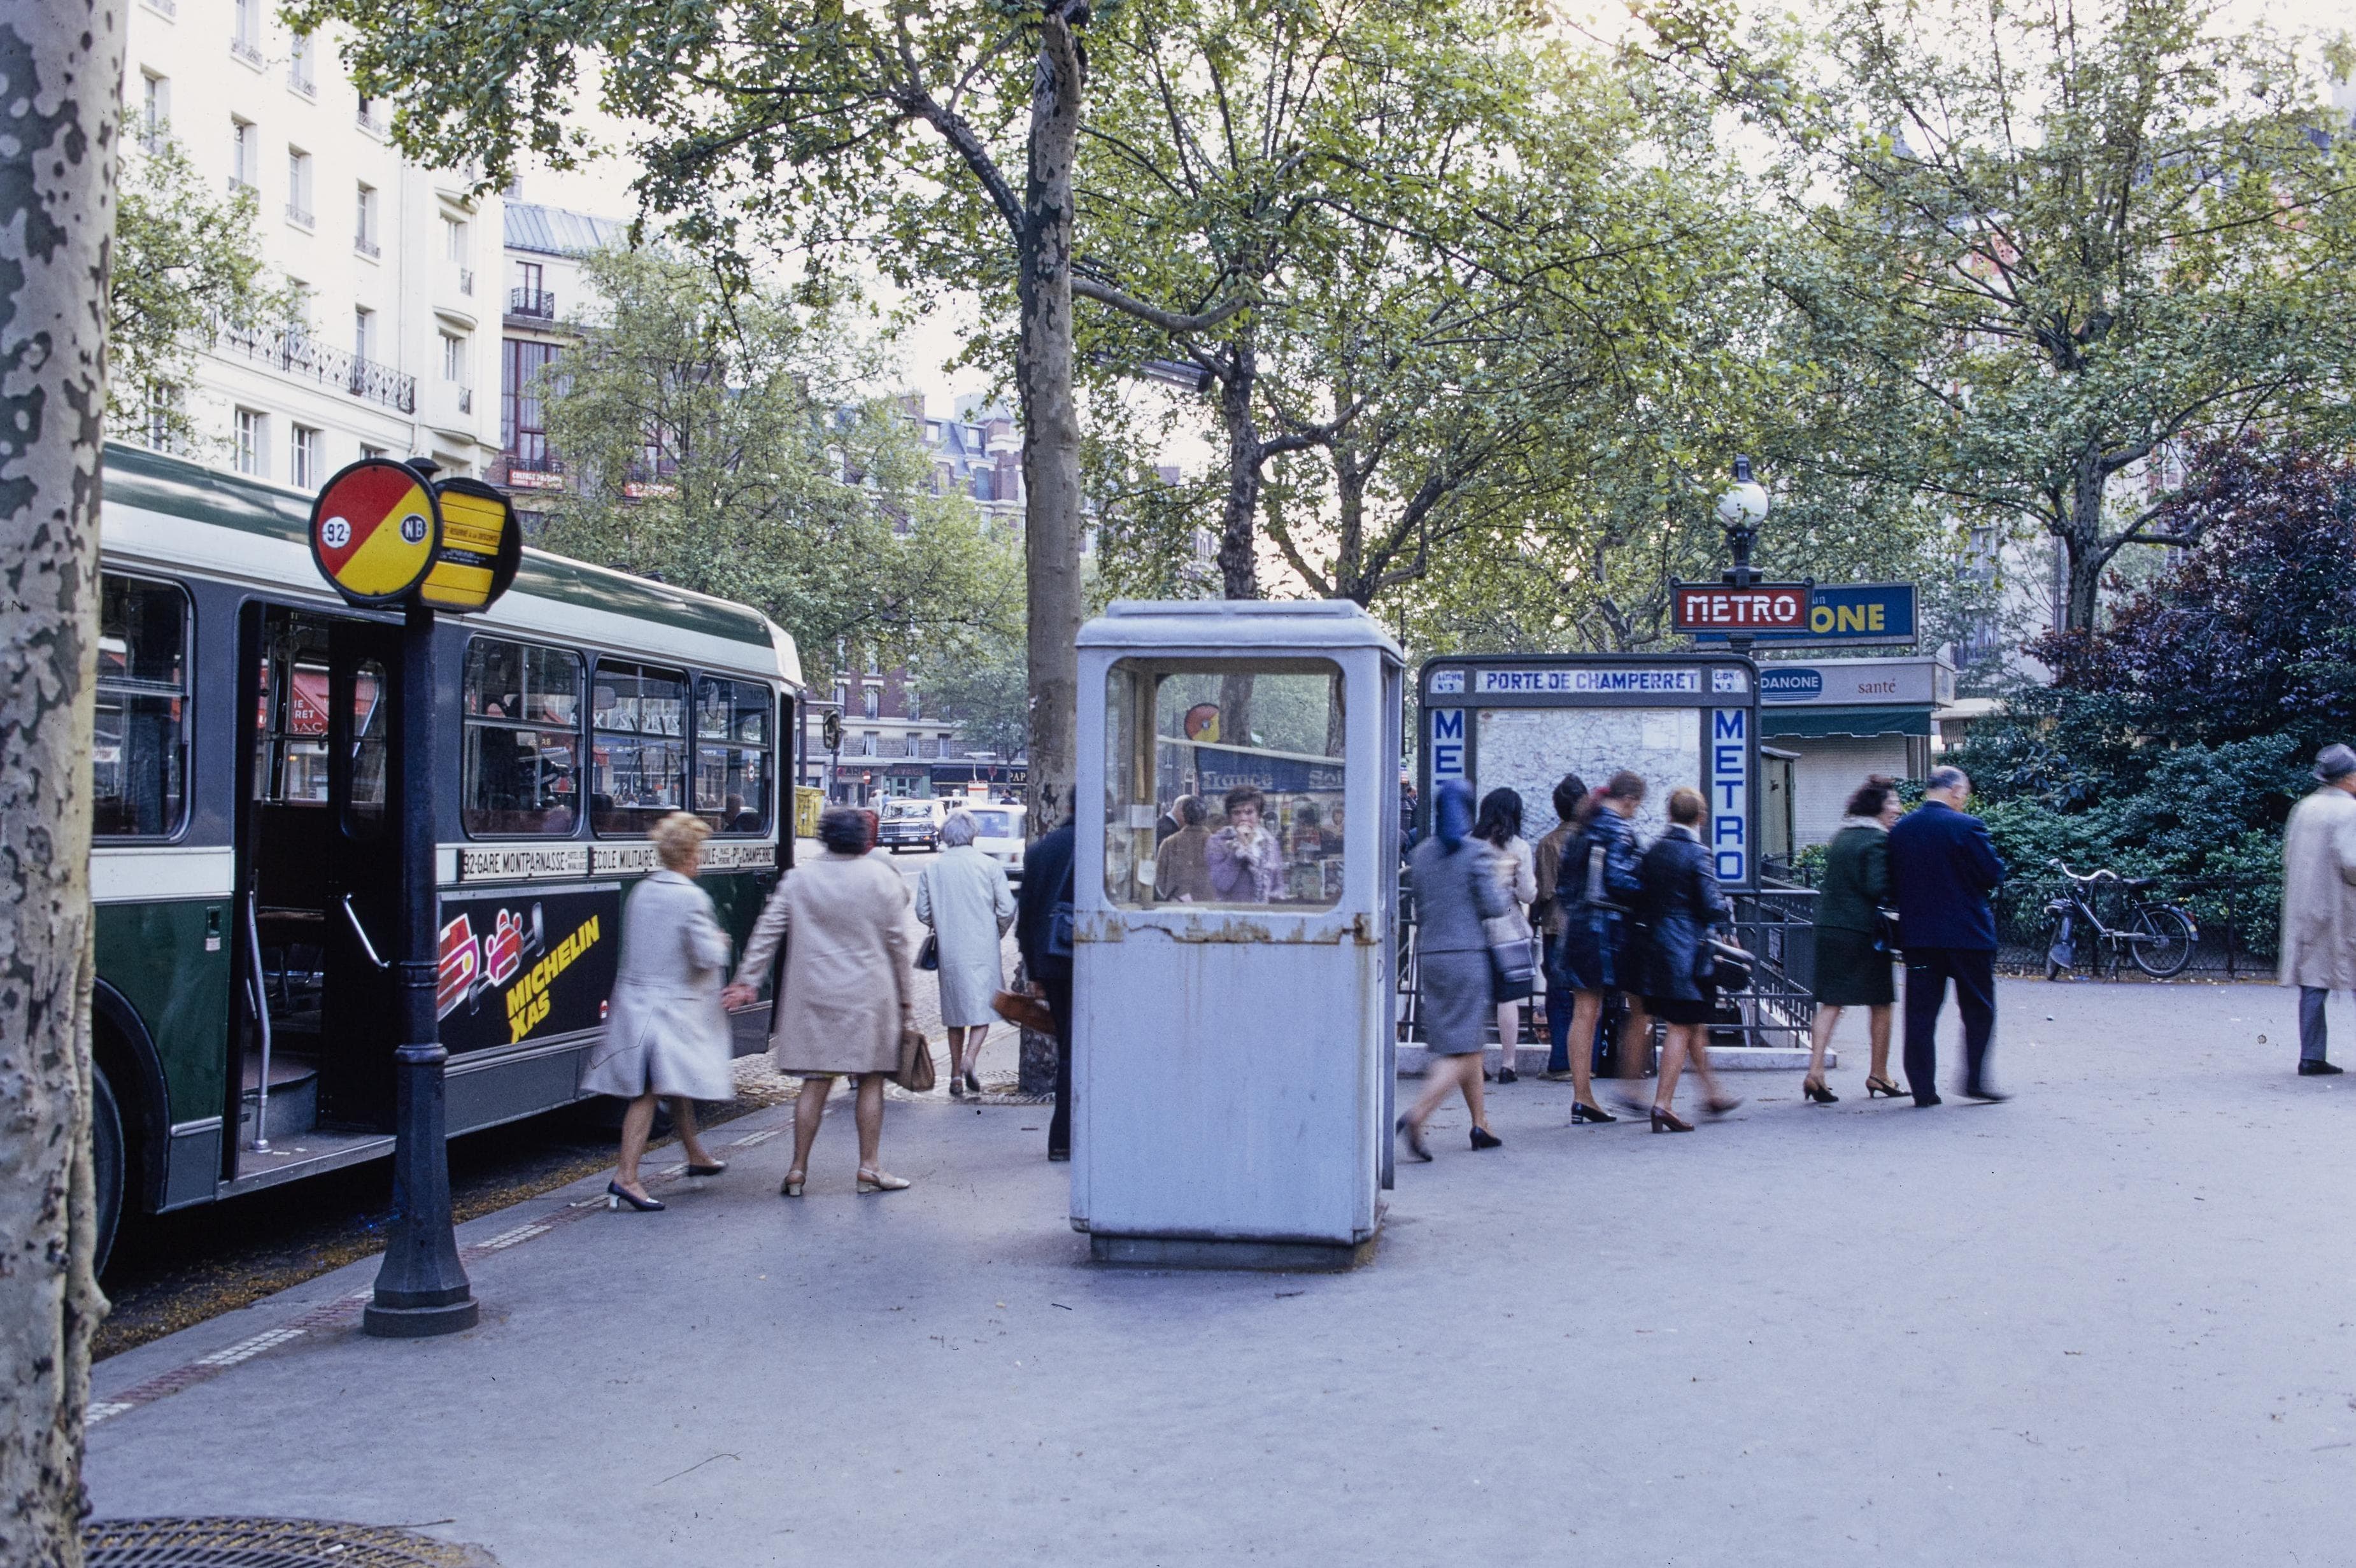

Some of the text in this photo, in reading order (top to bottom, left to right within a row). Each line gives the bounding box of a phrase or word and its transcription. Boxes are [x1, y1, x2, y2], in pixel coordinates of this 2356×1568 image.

[327, 524, 345, 542] 92
[405, 518, 424, 540] NB
[1686, 595, 1796, 622] METRO
[1487, 672, 1698, 689] PORTE DE CHAMPERRET
[1760, 675, 1819, 689] DANONE
[1858, 677, 1896, 695] santé
[1715, 709, 1743, 880] METRO
[593, 850, 616, 870] ECOLE
[506, 914, 600, 1019] MICHELIN
[509, 989, 551, 1045] XAS
